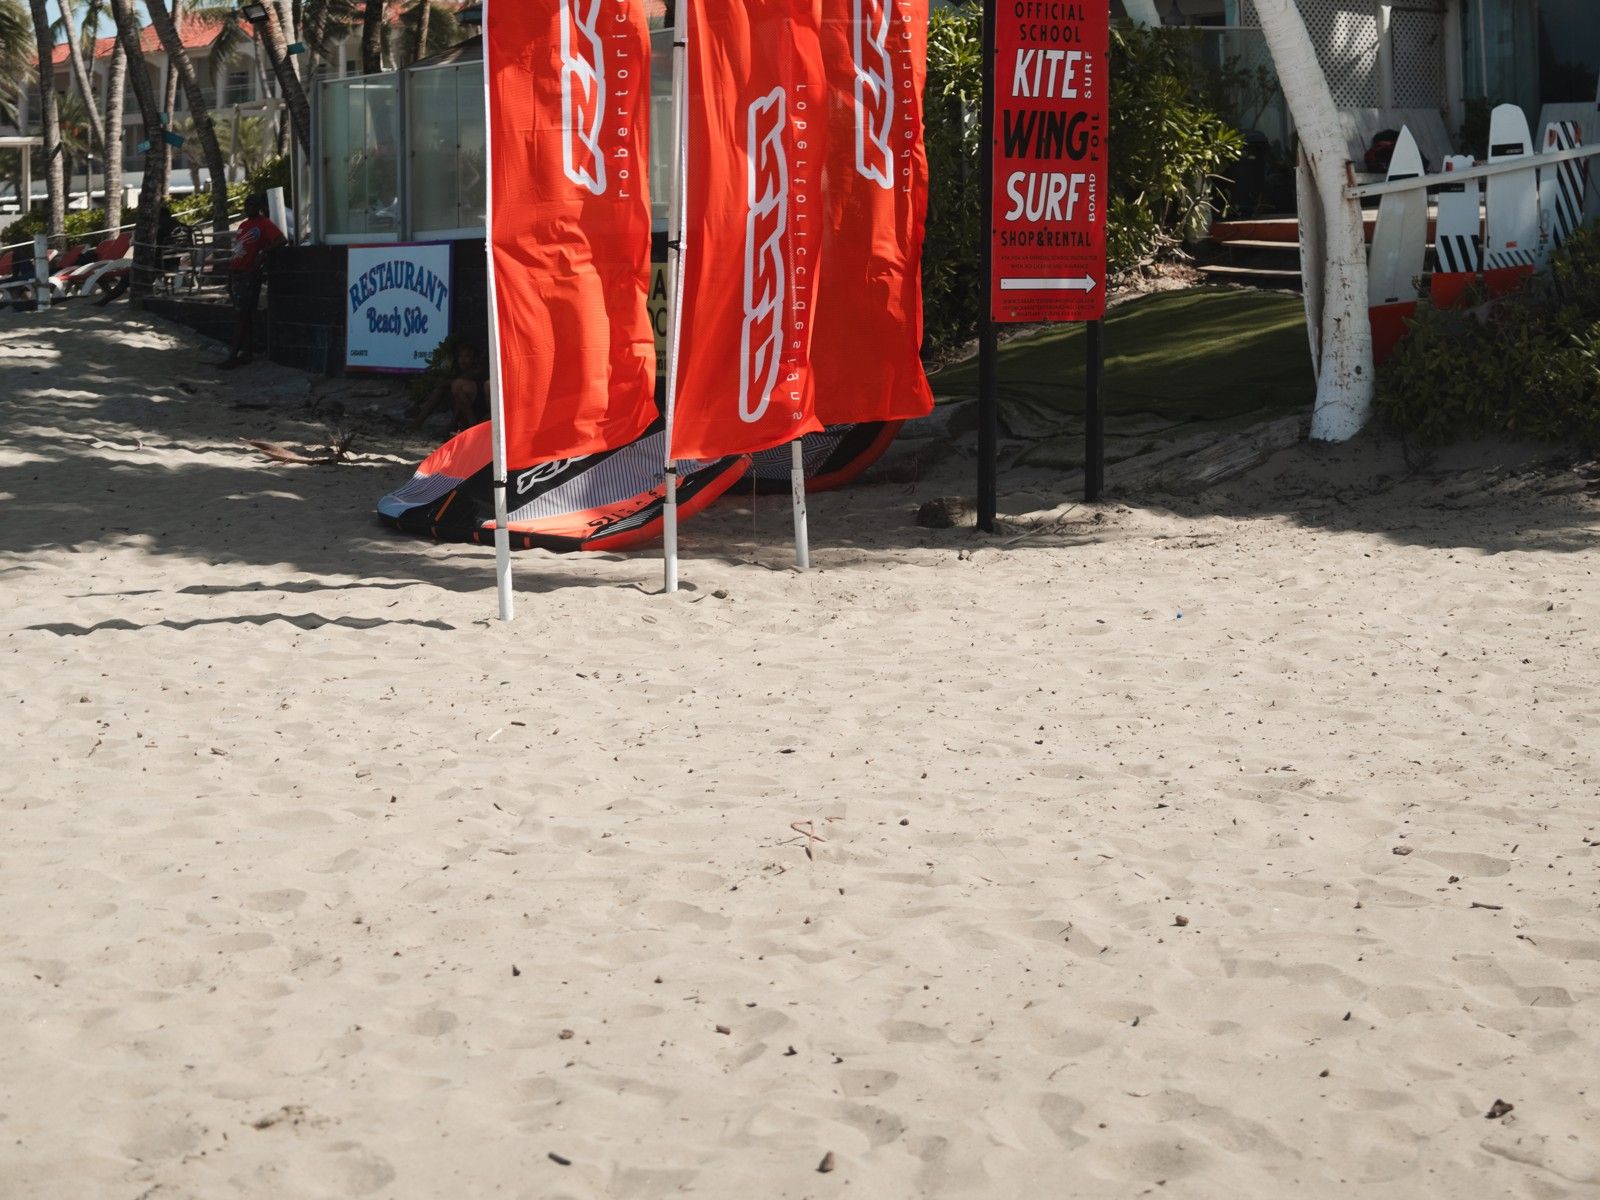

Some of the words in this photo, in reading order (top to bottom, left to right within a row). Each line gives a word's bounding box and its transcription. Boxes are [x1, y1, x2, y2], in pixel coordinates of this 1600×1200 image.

[1014, 1, 1085, 21] OFFICIAL
[1020, 24, 1081, 42] SCHOOL
[1012, 48, 1082, 99] KITE
[1084, 51, 1092, 99] SURF
[1003, 109, 1089, 161] WING
[1091, 112, 1099, 161] FOIL
[1005, 171, 1086, 222] SURF
[1088, 173, 1096, 222] BOARD
[1001, 231, 1092, 247] SHOP&RENTAL
[349, 260, 448, 314] RESTAURANT
[366, 306, 401, 336] Beach
[403, 306, 428, 337] Side
